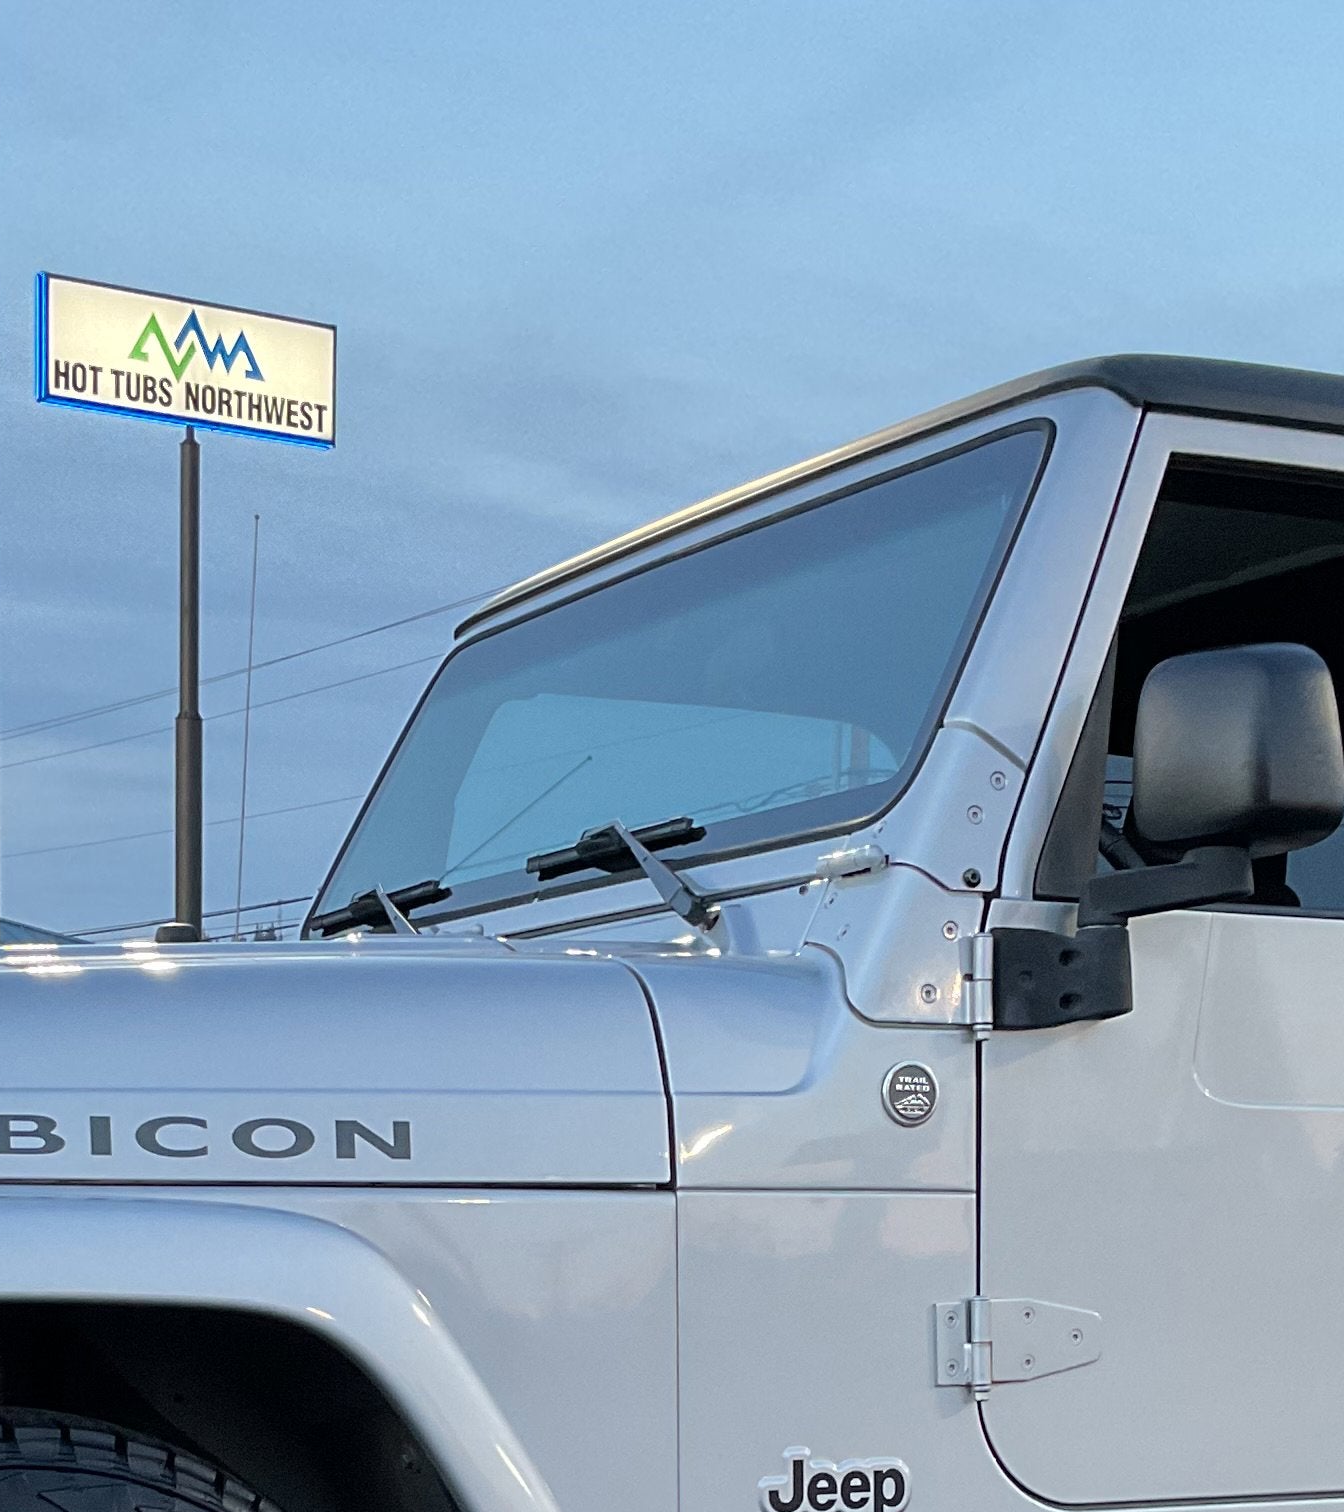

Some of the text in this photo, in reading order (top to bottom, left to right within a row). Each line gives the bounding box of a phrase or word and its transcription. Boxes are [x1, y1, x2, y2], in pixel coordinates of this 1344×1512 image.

[54, 359, 328, 433] HOT TUBS NORTHWEST
[898, 1076, 929, 1085] TRAIL
[895, 1084, 930, 1092] RATED
